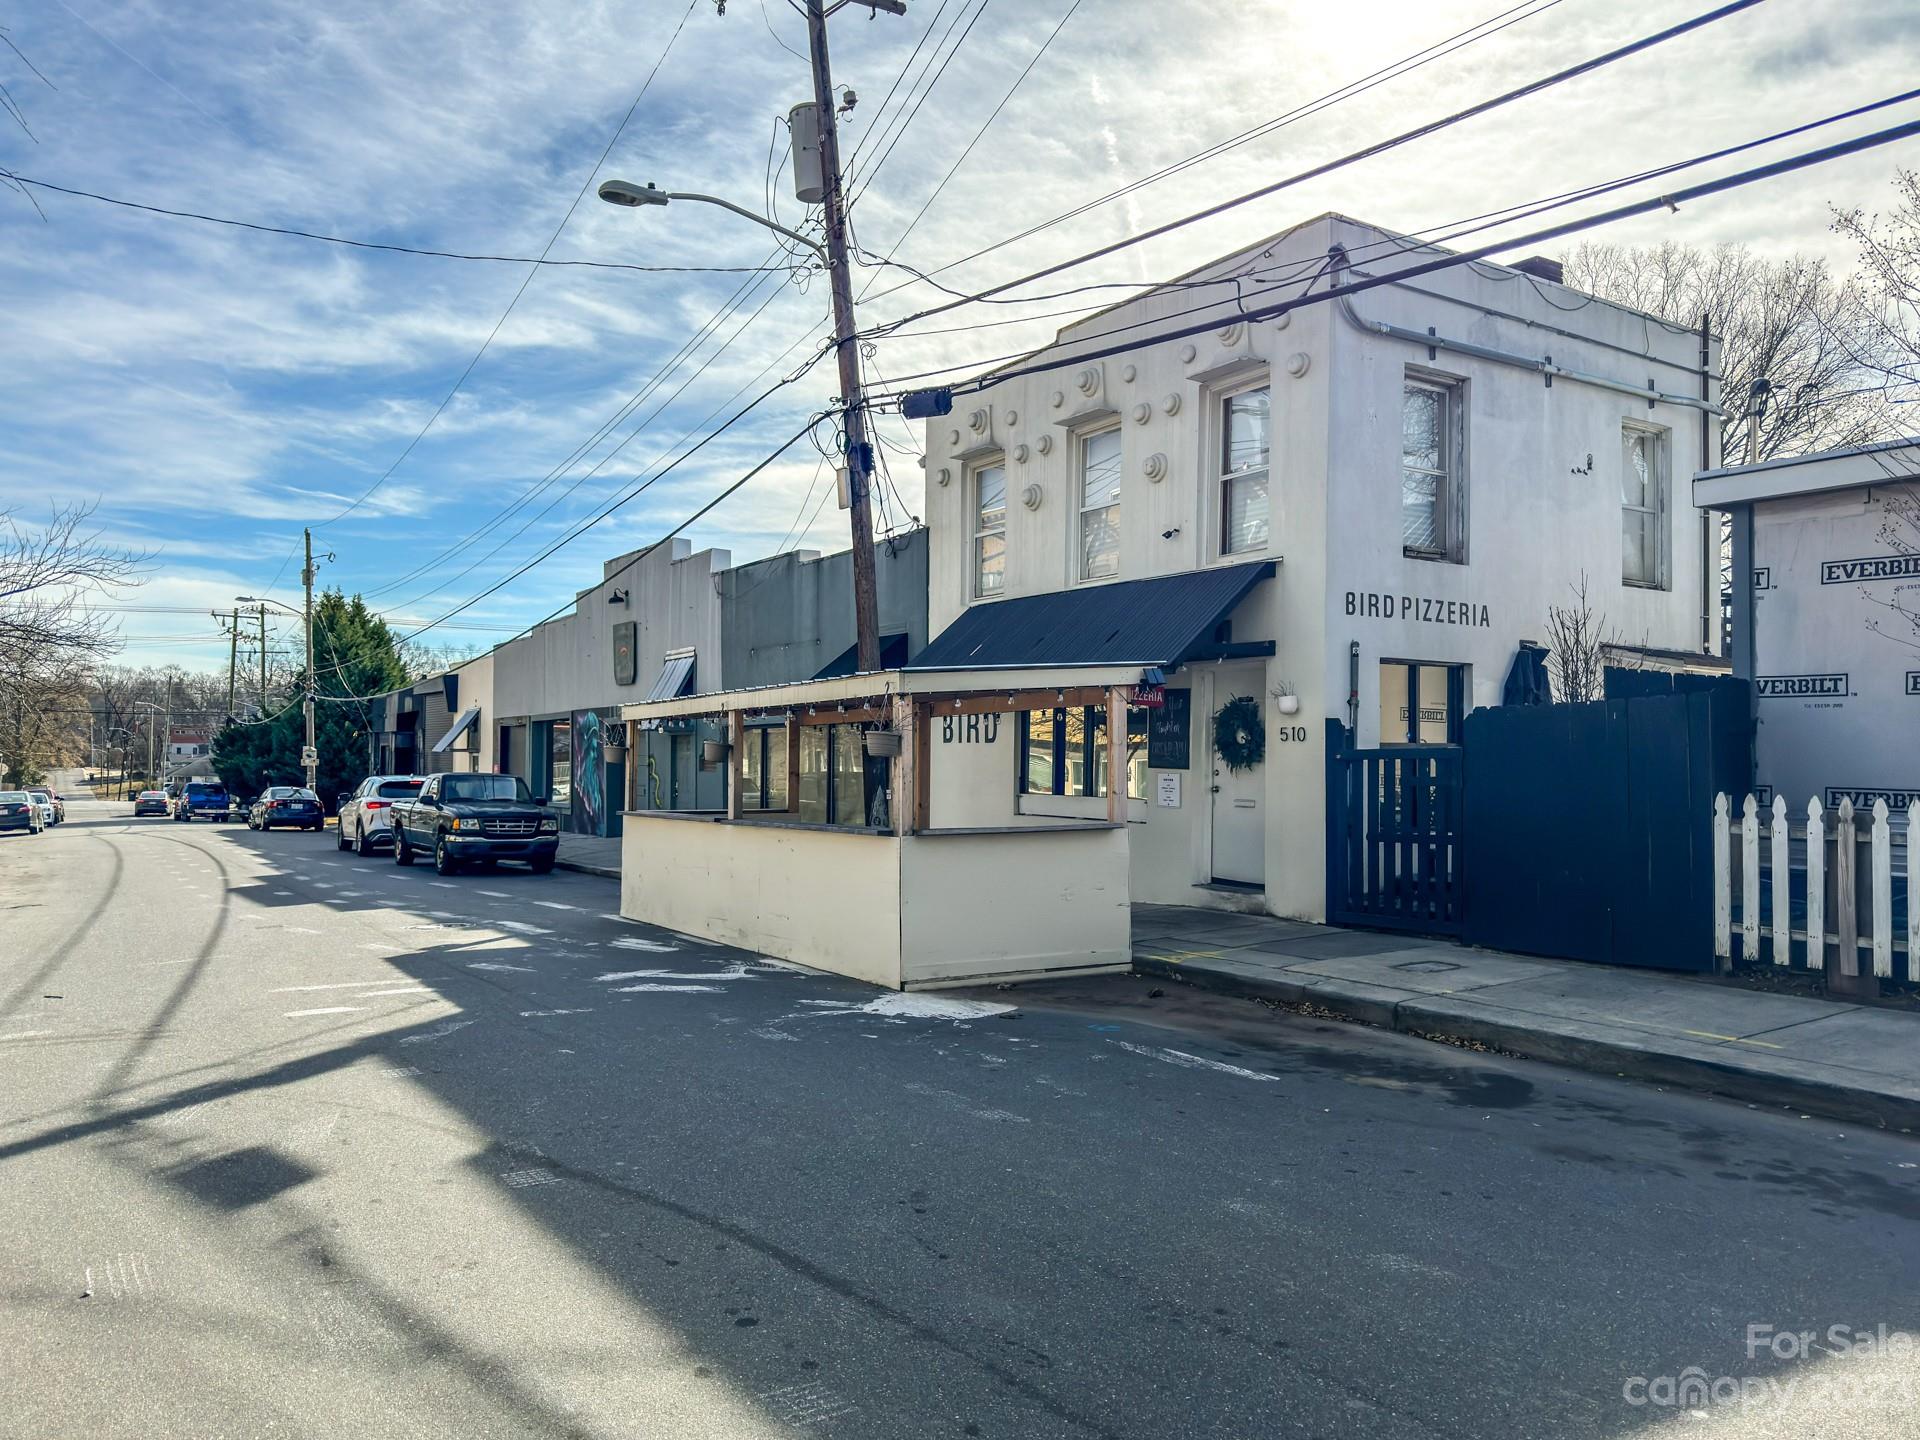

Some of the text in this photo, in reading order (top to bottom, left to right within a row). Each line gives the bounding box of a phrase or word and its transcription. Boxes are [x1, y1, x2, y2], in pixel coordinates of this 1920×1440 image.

[1345, 591, 1490, 627] BIRD PIZZERIA
[1756, 677, 1843, 695] VERBILT
[943, 713, 998, 743] BIRD
[1280, 726, 1306, 742] 510
